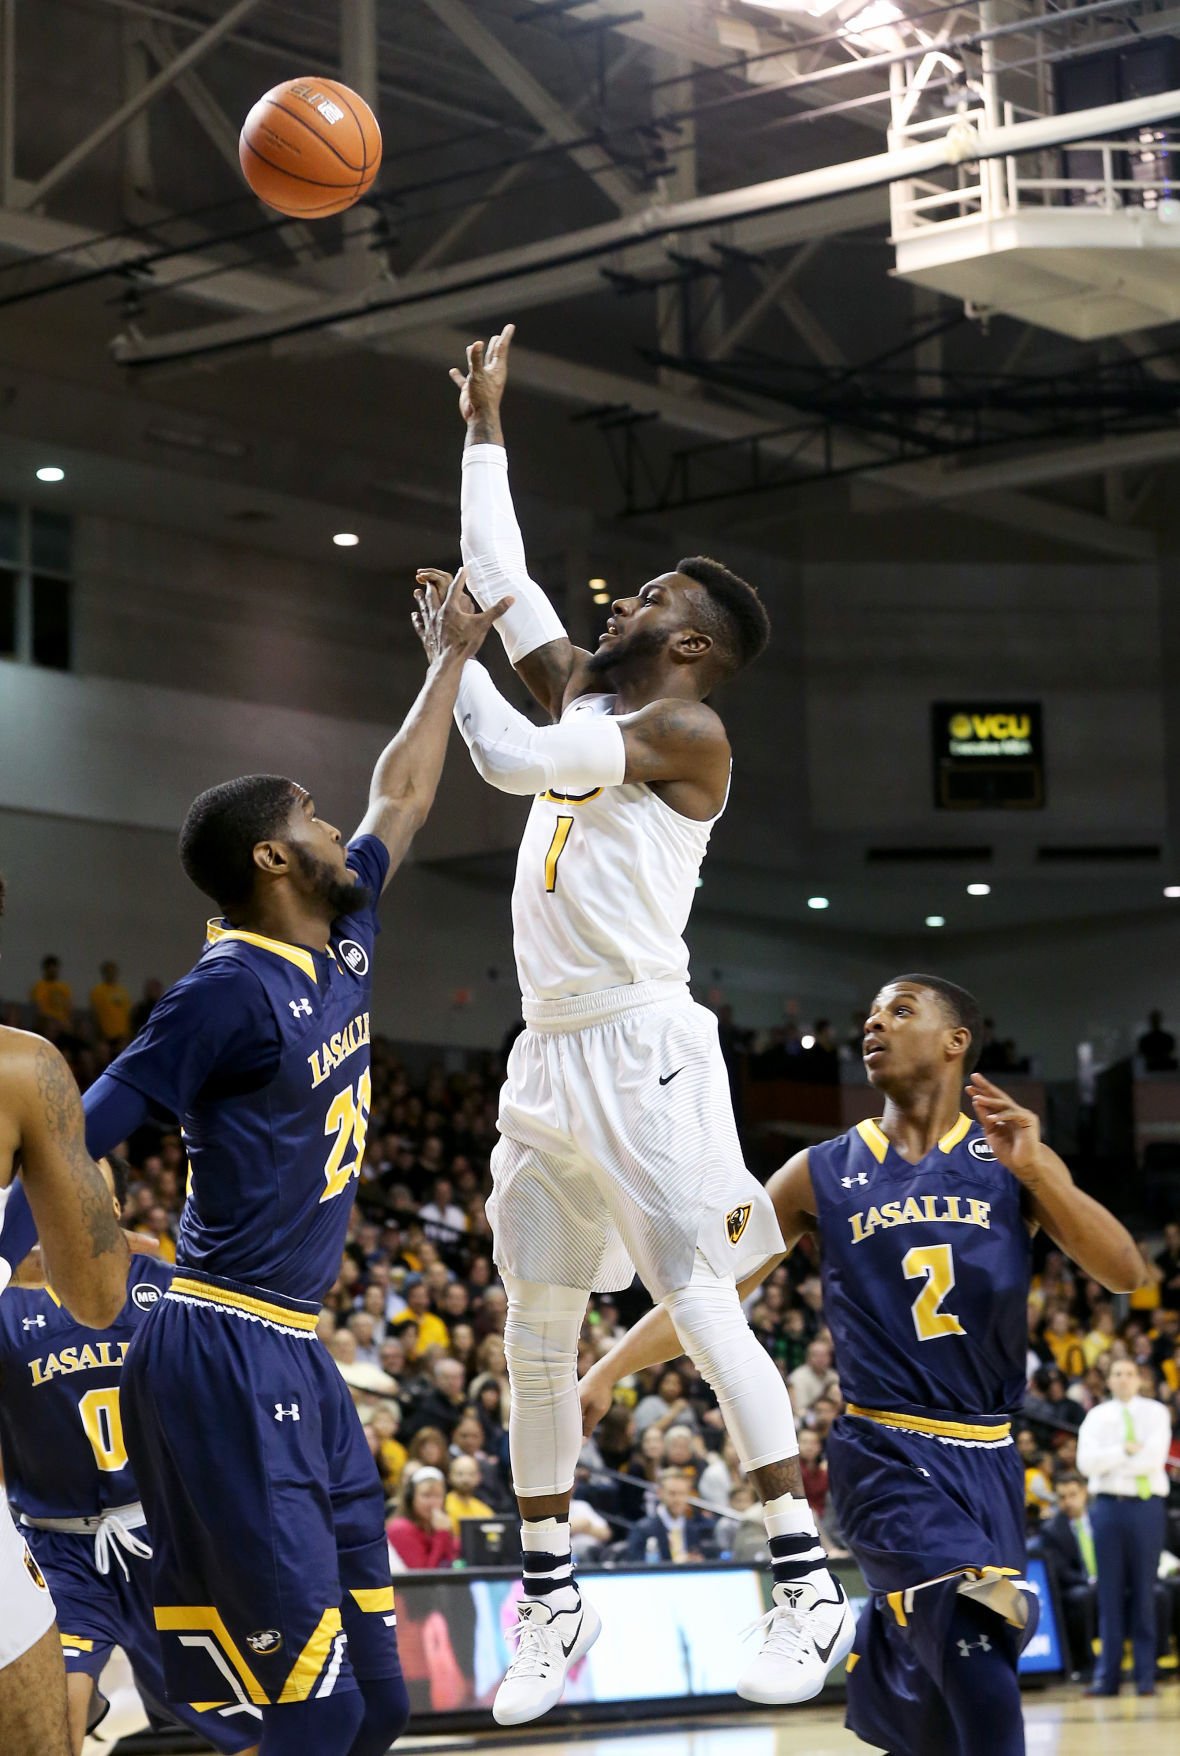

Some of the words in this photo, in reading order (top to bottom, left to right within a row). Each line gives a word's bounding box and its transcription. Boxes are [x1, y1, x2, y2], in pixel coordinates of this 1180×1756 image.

[971, 713, 1031, 739] VCU
[545, 815, 574, 893] 1
[345, 948, 363, 968] MB
[848, 1195, 991, 1244] LASALLE
[136, 1291, 158, 1303] MB
[901, 1243, 967, 1342] 2
[78, 1386, 129, 1472] 0
